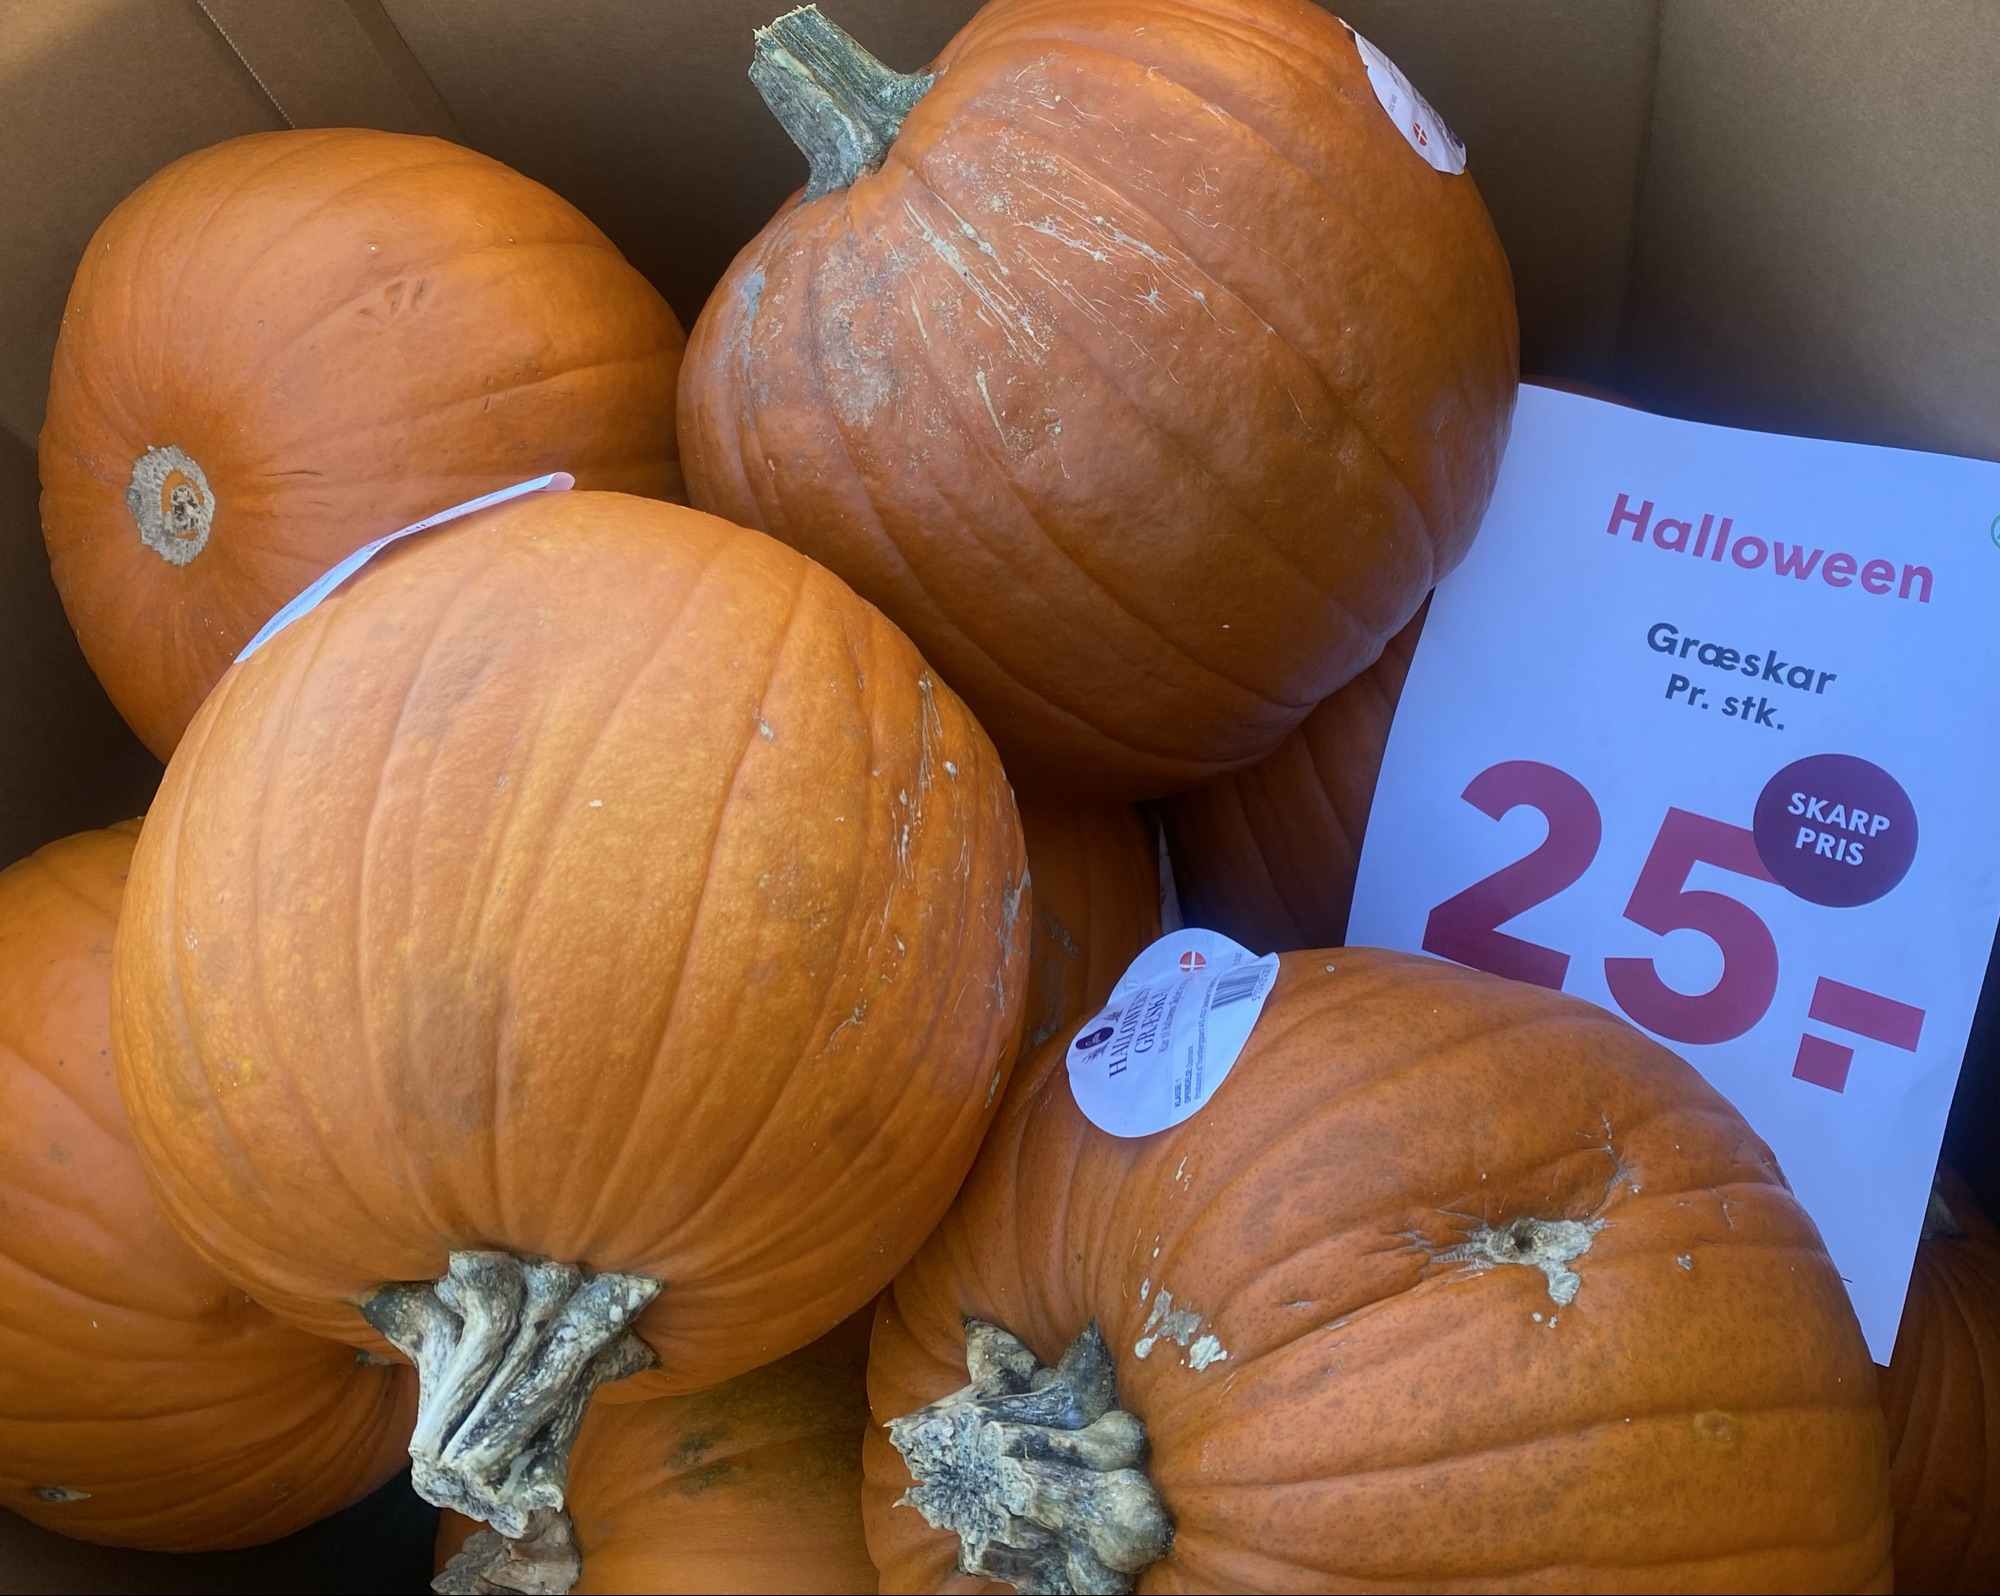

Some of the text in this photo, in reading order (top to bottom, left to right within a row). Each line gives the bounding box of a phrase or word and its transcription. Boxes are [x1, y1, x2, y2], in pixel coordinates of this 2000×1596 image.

[1606, 493, 1935, 604] Halloween
[1647, 622, 1838, 695] Græskar
[1664, 673, 1785, 731] Pr. stk.
[1787, 792, 1891, 838] SKARP
[1795, 826, 1865, 866] PRIS
